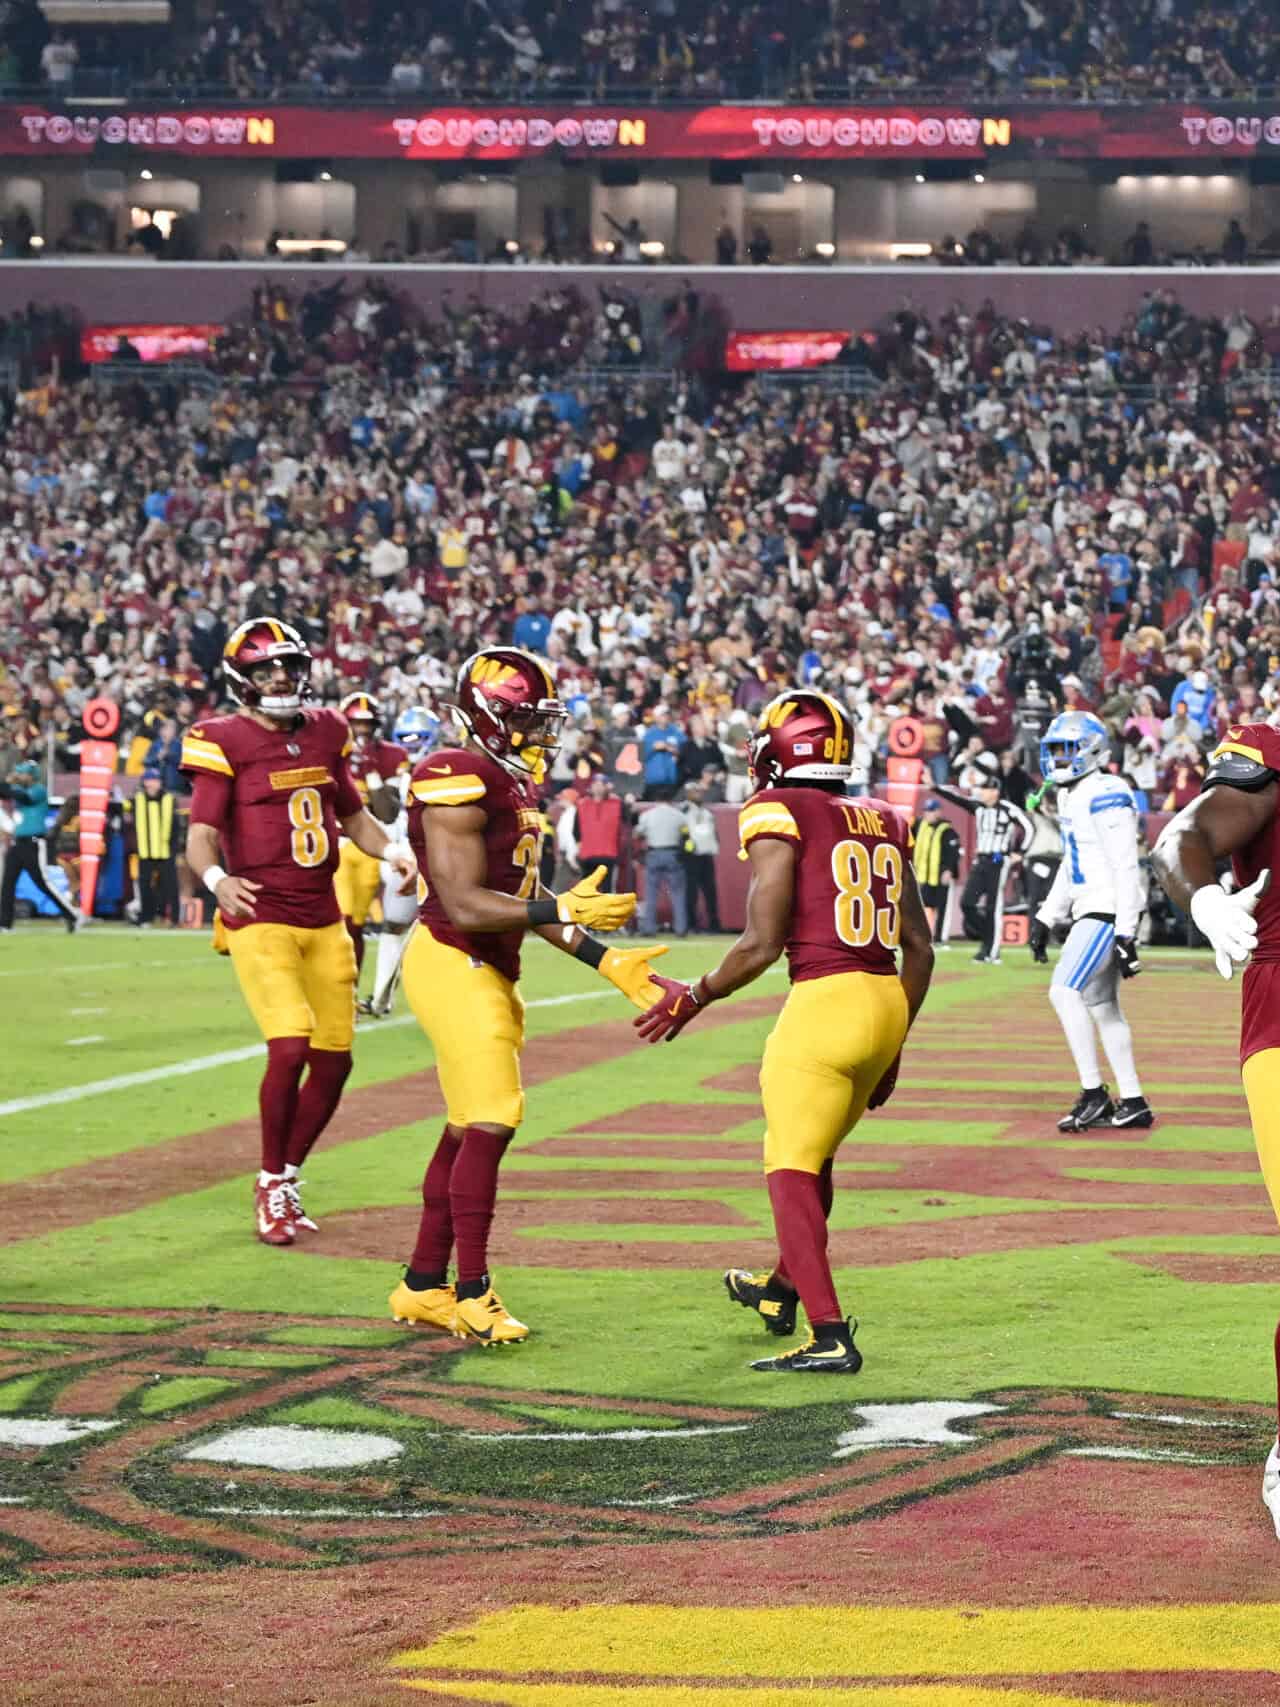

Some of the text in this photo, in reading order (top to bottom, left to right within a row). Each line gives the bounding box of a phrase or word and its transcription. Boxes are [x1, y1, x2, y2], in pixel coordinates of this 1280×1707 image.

[21, 115, 275, 145] TOUCHDOWN
[392, 117, 646, 147] TOUCHDOWN
[752, 117, 1010, 147] TOUCHDOWN
[288, 787, 330, 868] 8
[841, 806, 888, 838] LANE
[831, 839, 903, 950] 83
